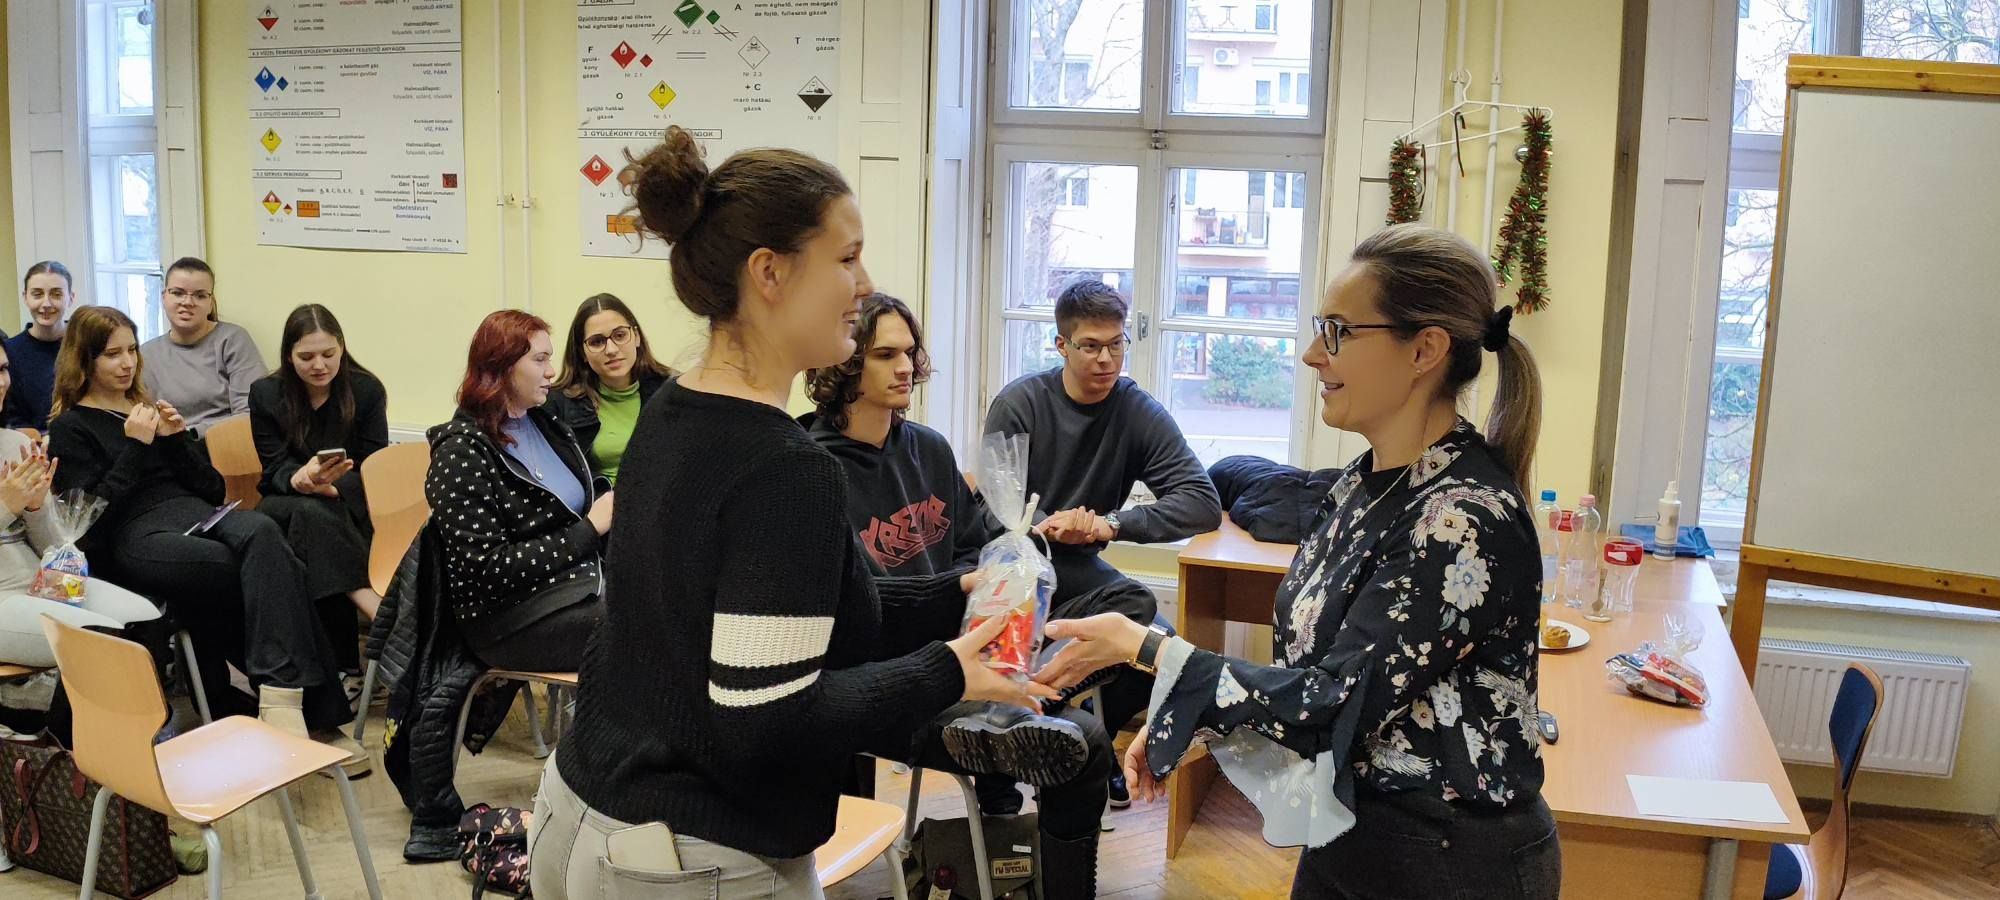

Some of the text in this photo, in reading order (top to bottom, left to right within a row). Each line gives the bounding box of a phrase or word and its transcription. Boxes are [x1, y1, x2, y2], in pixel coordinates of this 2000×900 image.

[734, 3, 743, 11] A
[794, 36, 801, 45] T
[753, 83, 761, 91] C
